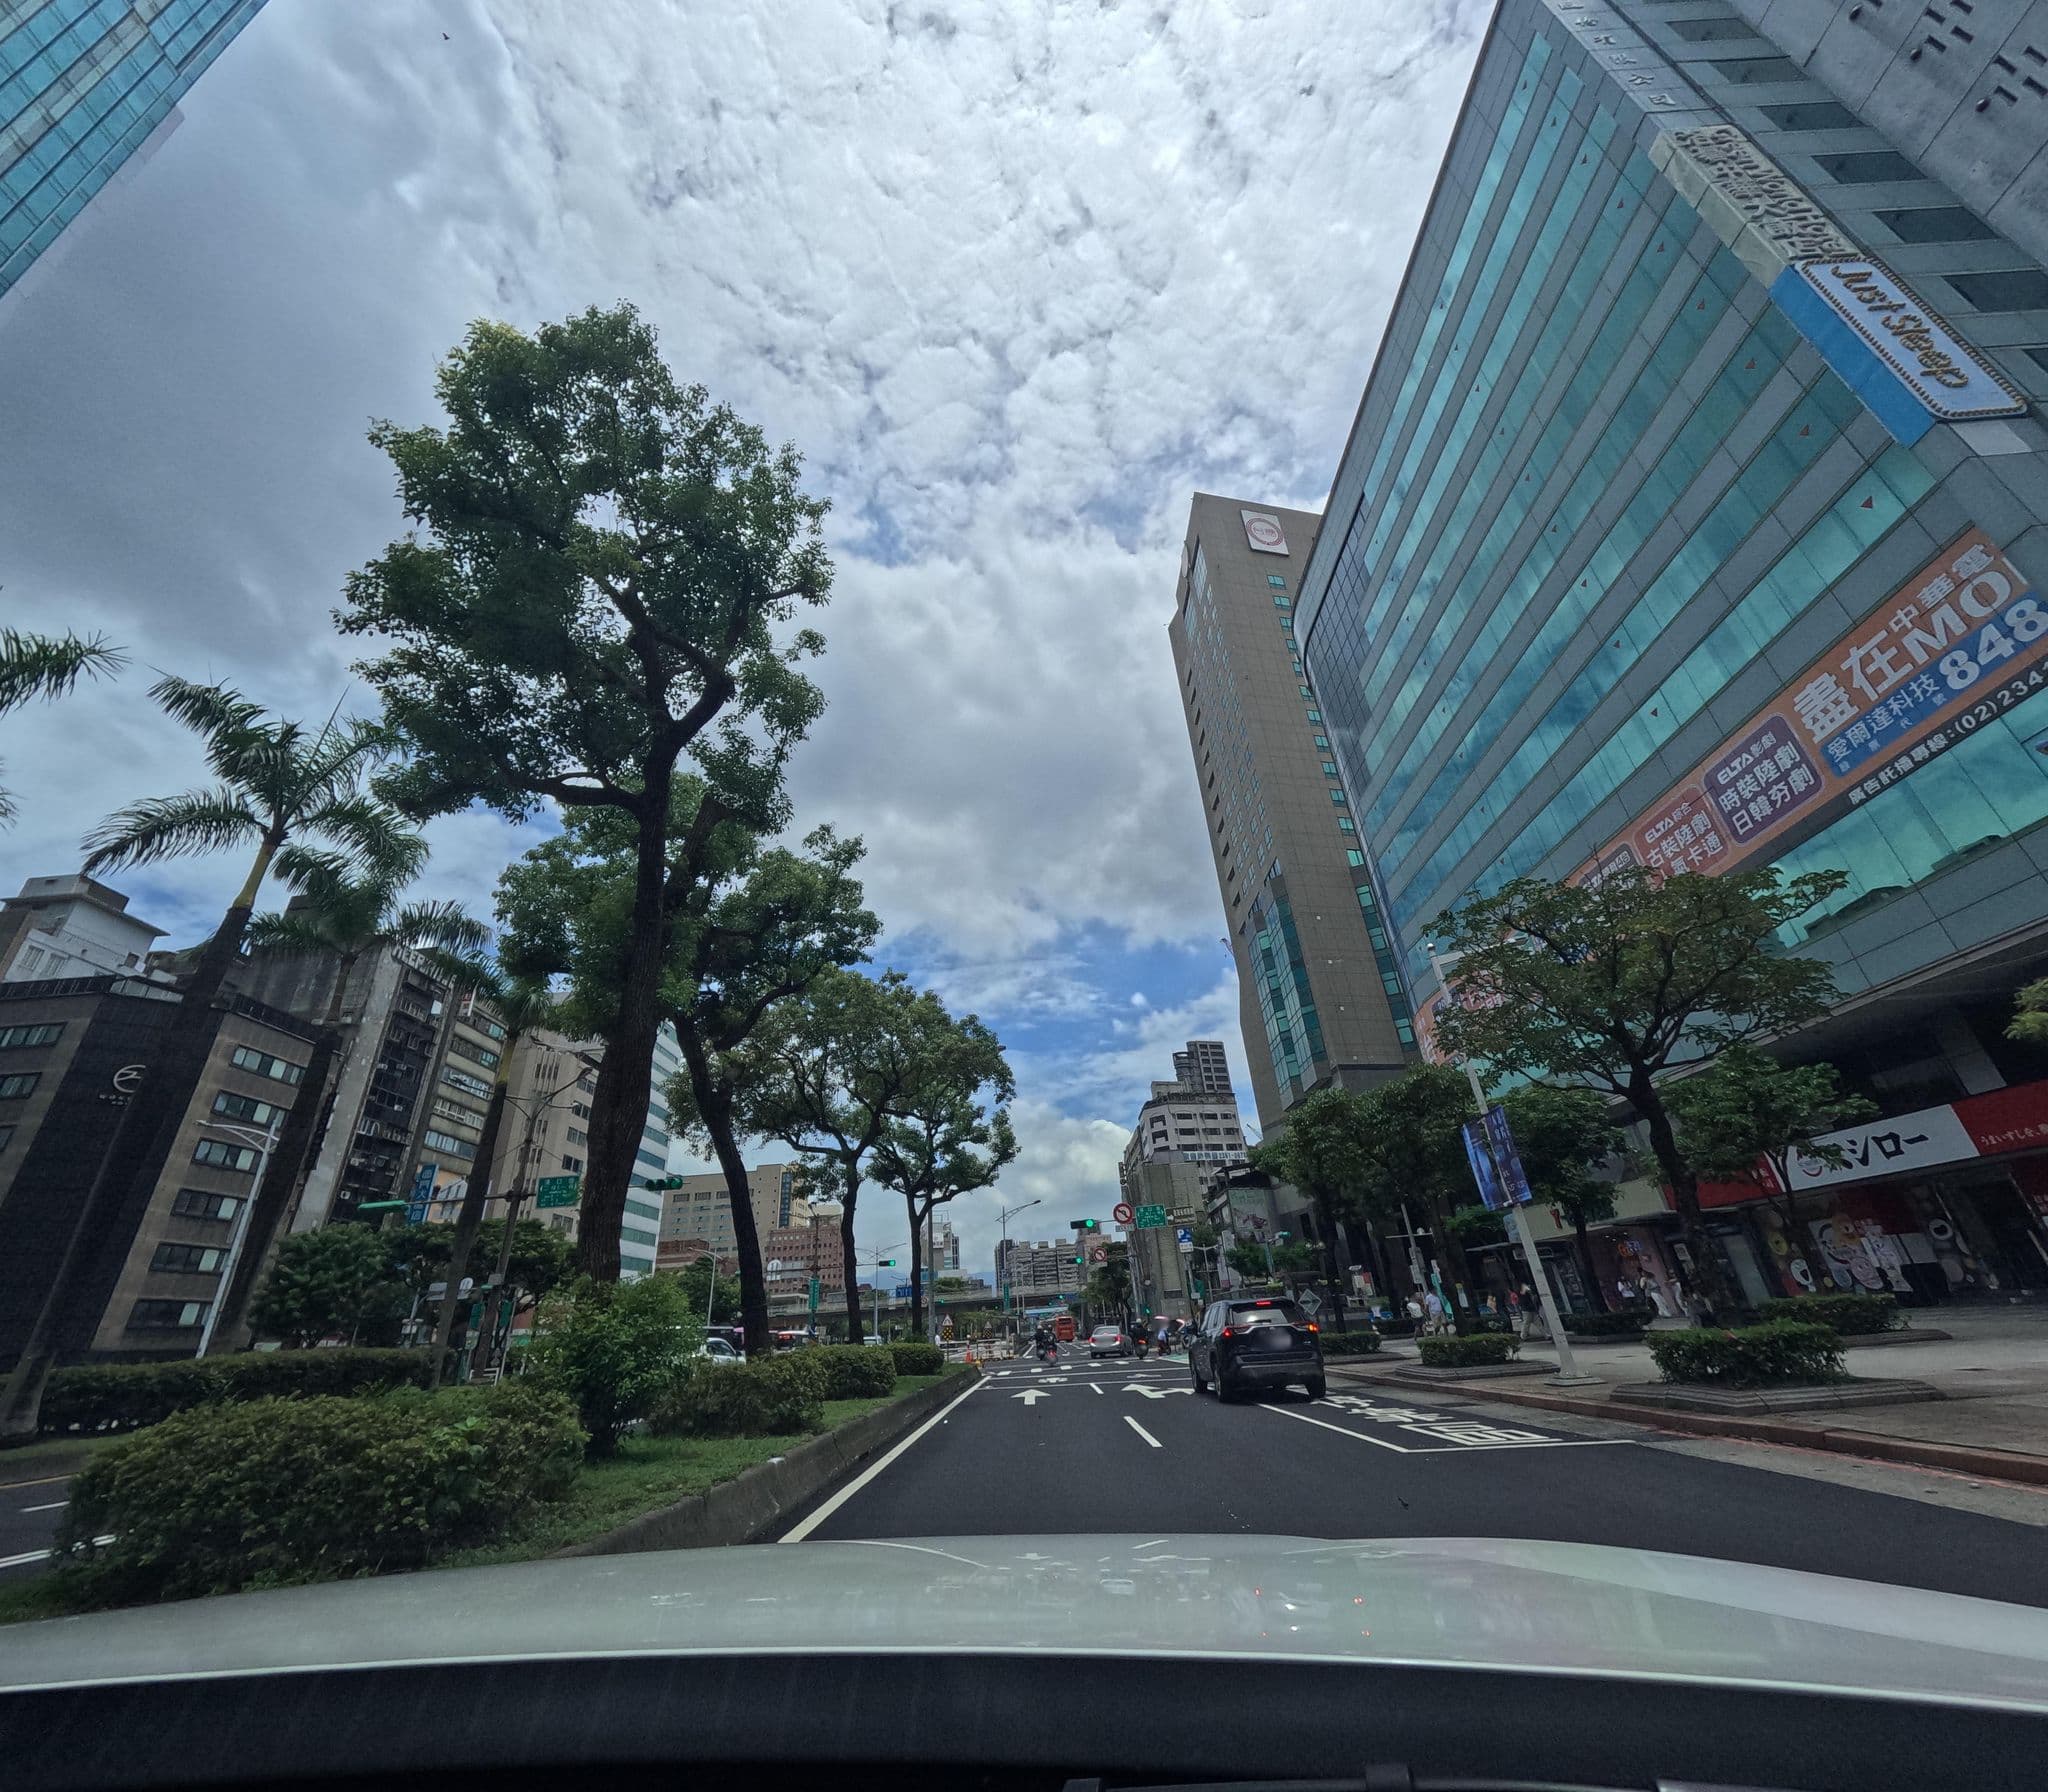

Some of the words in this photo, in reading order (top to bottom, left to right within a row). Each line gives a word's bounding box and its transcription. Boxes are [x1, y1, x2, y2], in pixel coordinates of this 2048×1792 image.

[1831, 264, 1905, 323] Just
[1882, 306, 1970, 389] Sleep
[1900, 556, 2029, 675] MO
[1793, 629, 1905, 745] 盡在
[1827, 673, 1941, 759] 愛爾達科技
[1718, 742, 1800, 814] 時裝陸劇
[1733, 767, 1816, 836] 日韓夯劇
[1646, 809, 1712, 866] 古裝陸劇
[1830, 1131, 1929, 1173] シロー
